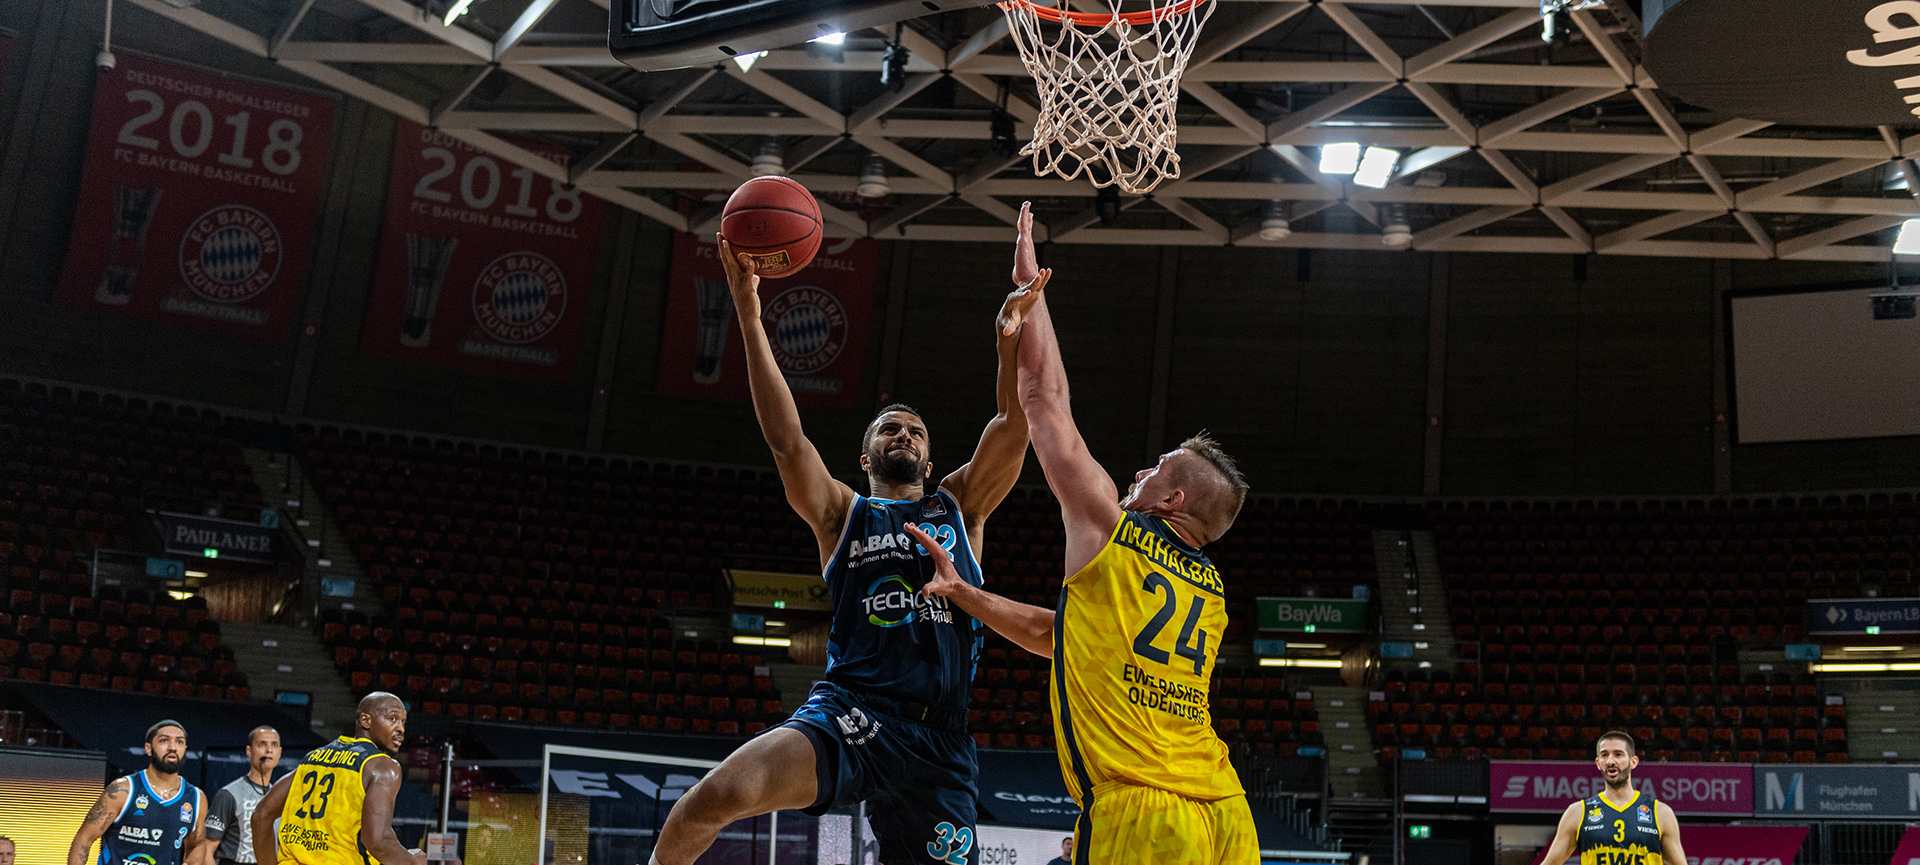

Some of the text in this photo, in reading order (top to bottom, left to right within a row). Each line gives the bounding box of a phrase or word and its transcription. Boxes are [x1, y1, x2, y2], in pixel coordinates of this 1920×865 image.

[126, 69, 213, 98] DEUTSCHER
[117, 89, 304, 176] 2018
[114, 148, 297, 193] FC BAYERN BASKETBALL
[413, 147, 583, 222] 2018
[191, 210, 277, 253] FC BAYERN
[411, 201, 578, 239] FC BAYERN BASKETBALL
[482, 256, 562, 296] FC BAYERN
[766, 290, 843, 327] FC BAYERN
[176, 525, 271, 551] PAULANER
[849, 533, 897, 558] ALBA
[916, 522, 956, 563] 32
[1133, 571, 1207, 677] 24
[1278, 603, 1342, 624] BayWa
[1129, 687, 1205, 725] OLDENBURG
[308, 748, 360, 766] PAULDING
[295, 771, 335, 819] 23
[1534, 776, 1742, 801] MAGETA SPORT
[1820, 784, 1877, 798] Flughafen
[1820, 801, 1873, 811] München
[119, 825, 149, 839] ALBA
[174, 827, 187, 849] 3
[282, 835, 329, 851] OLDENBURG
[927, 821, 973, 865] 32
[1613, 819, 1625, 843] 3
[979, 843, 1017, 865] tsche
